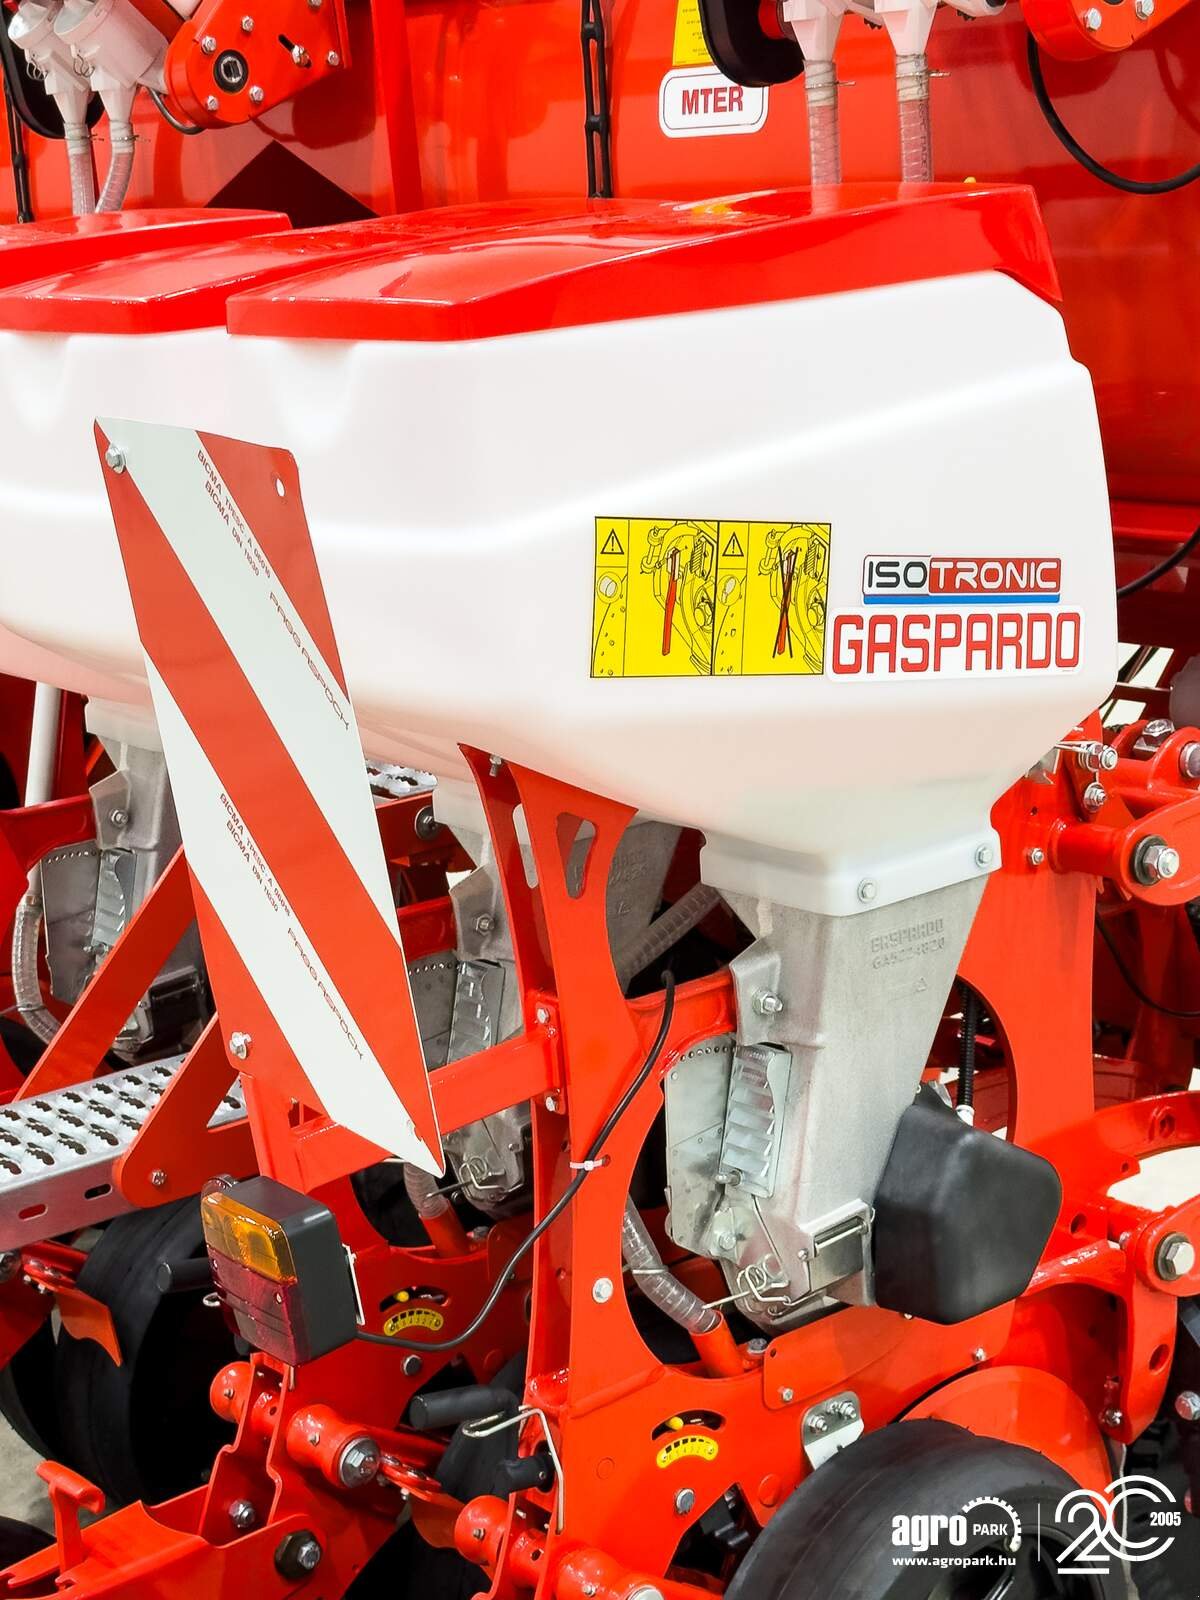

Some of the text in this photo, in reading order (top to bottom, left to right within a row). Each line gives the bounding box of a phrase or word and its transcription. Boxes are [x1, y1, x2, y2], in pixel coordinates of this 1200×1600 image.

[682, 86, 744, 116] MTER
[197, 449, 223, 496] BICMA
[205, 480, 230, 526] BICMA
[867, 560, 1059, 590] ISOTRONIC
[832, 612, 1081, 675] GASPARDO
[220, 793, 244, 836] BICMA
[226, 820, 251, 863] BICMA
